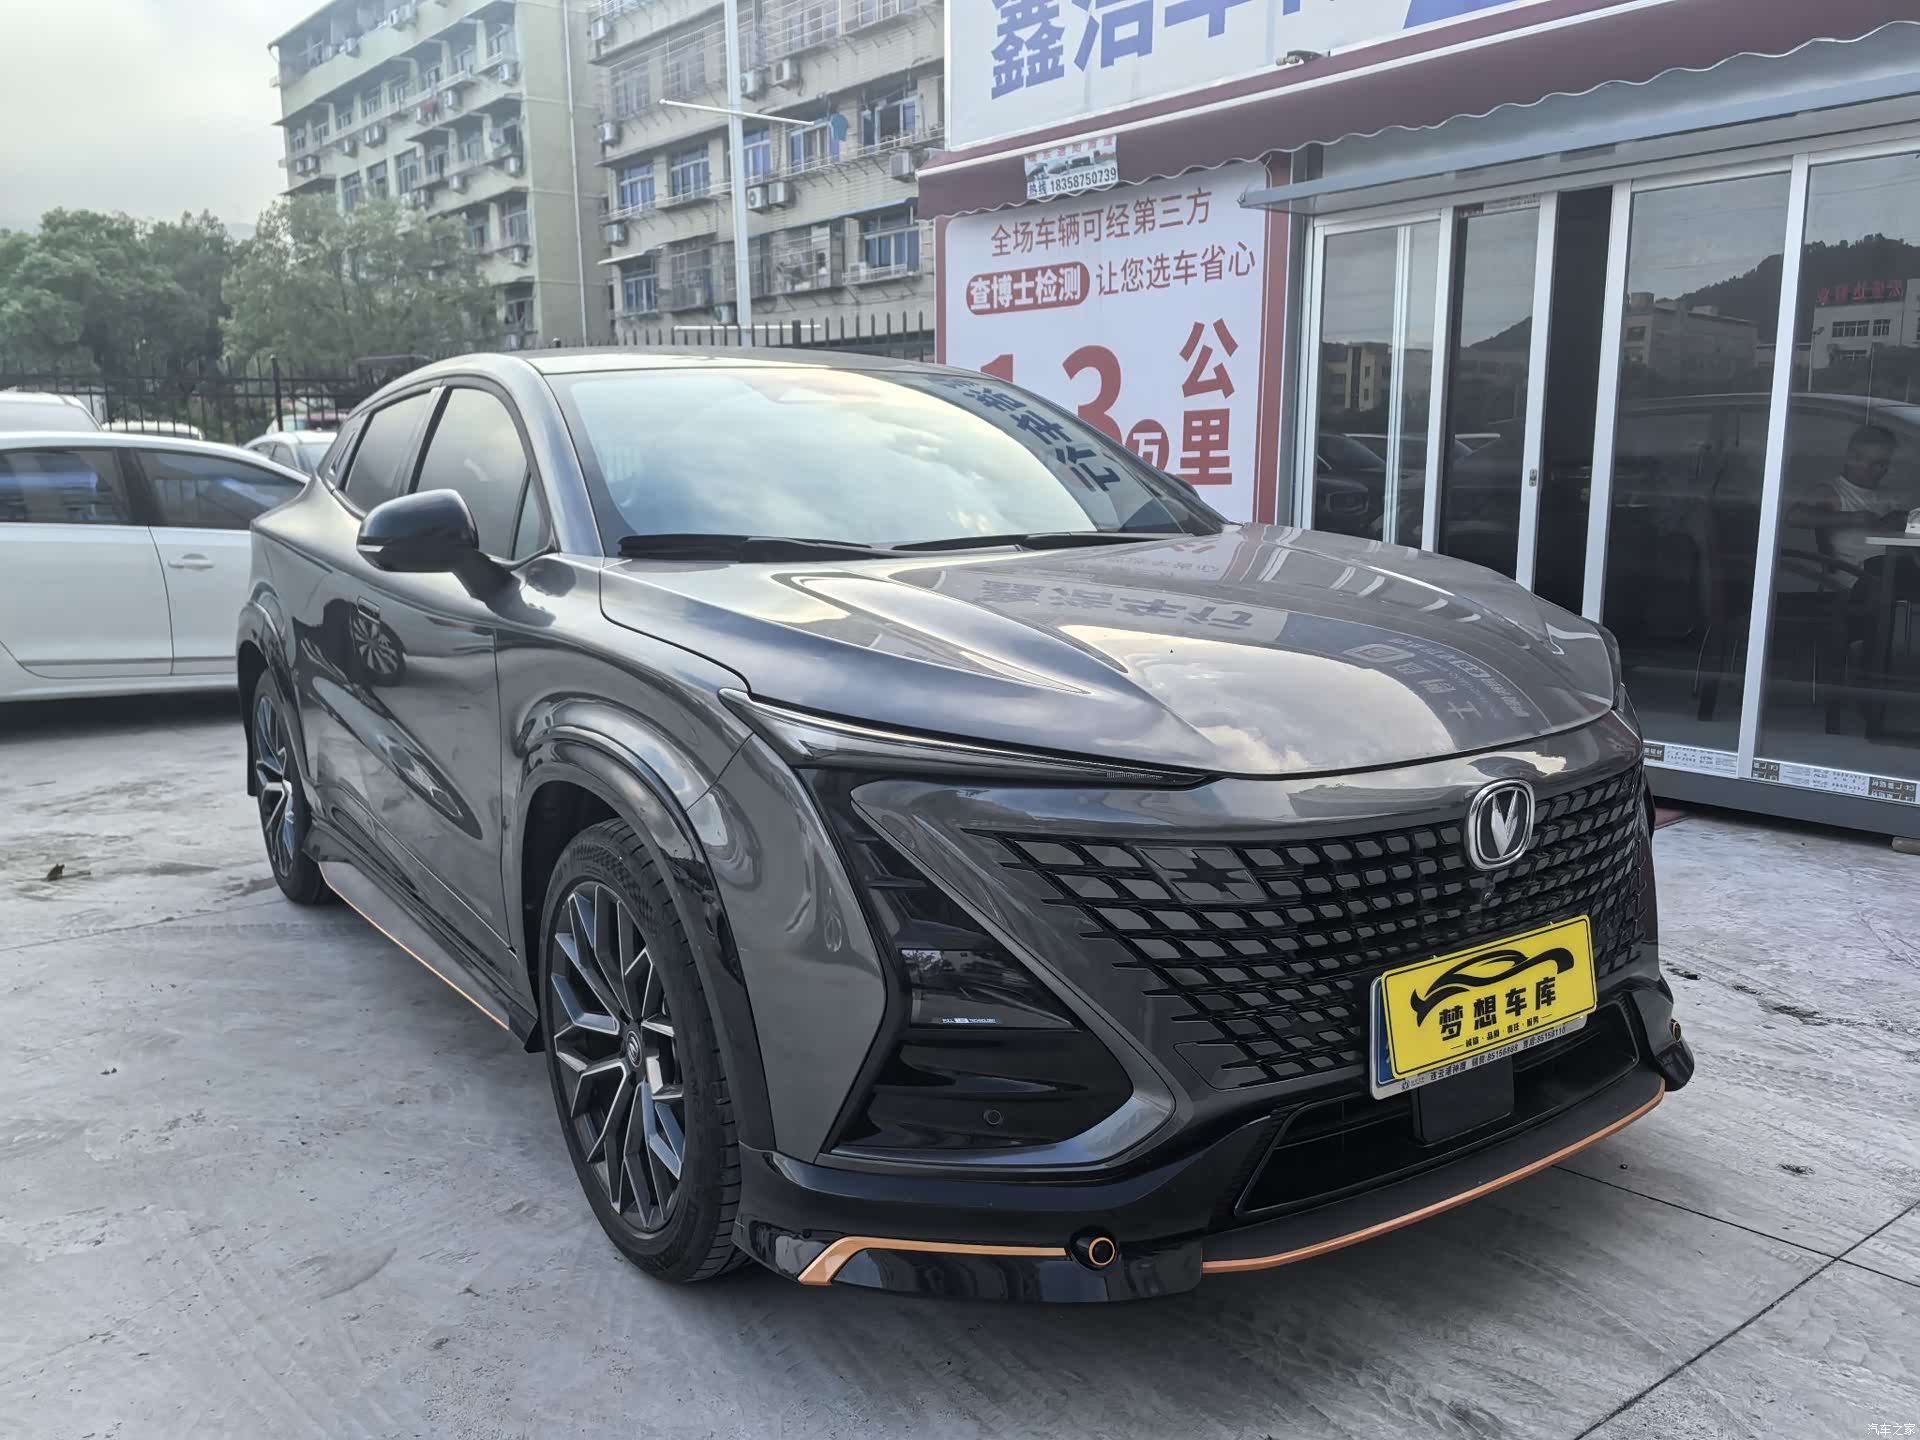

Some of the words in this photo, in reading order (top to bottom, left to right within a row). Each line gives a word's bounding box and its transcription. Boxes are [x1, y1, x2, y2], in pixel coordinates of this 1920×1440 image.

[1050, 166, 1117, 193] 18358750739
[990, 187, 1213, 257] 全场车辆可经第三方
[970, 264, 1082, 311] 查博士检测
[1095, 241, 1256, 297] 让您选车省心
[1439, 976, 1556, 1041] 梦想车库
